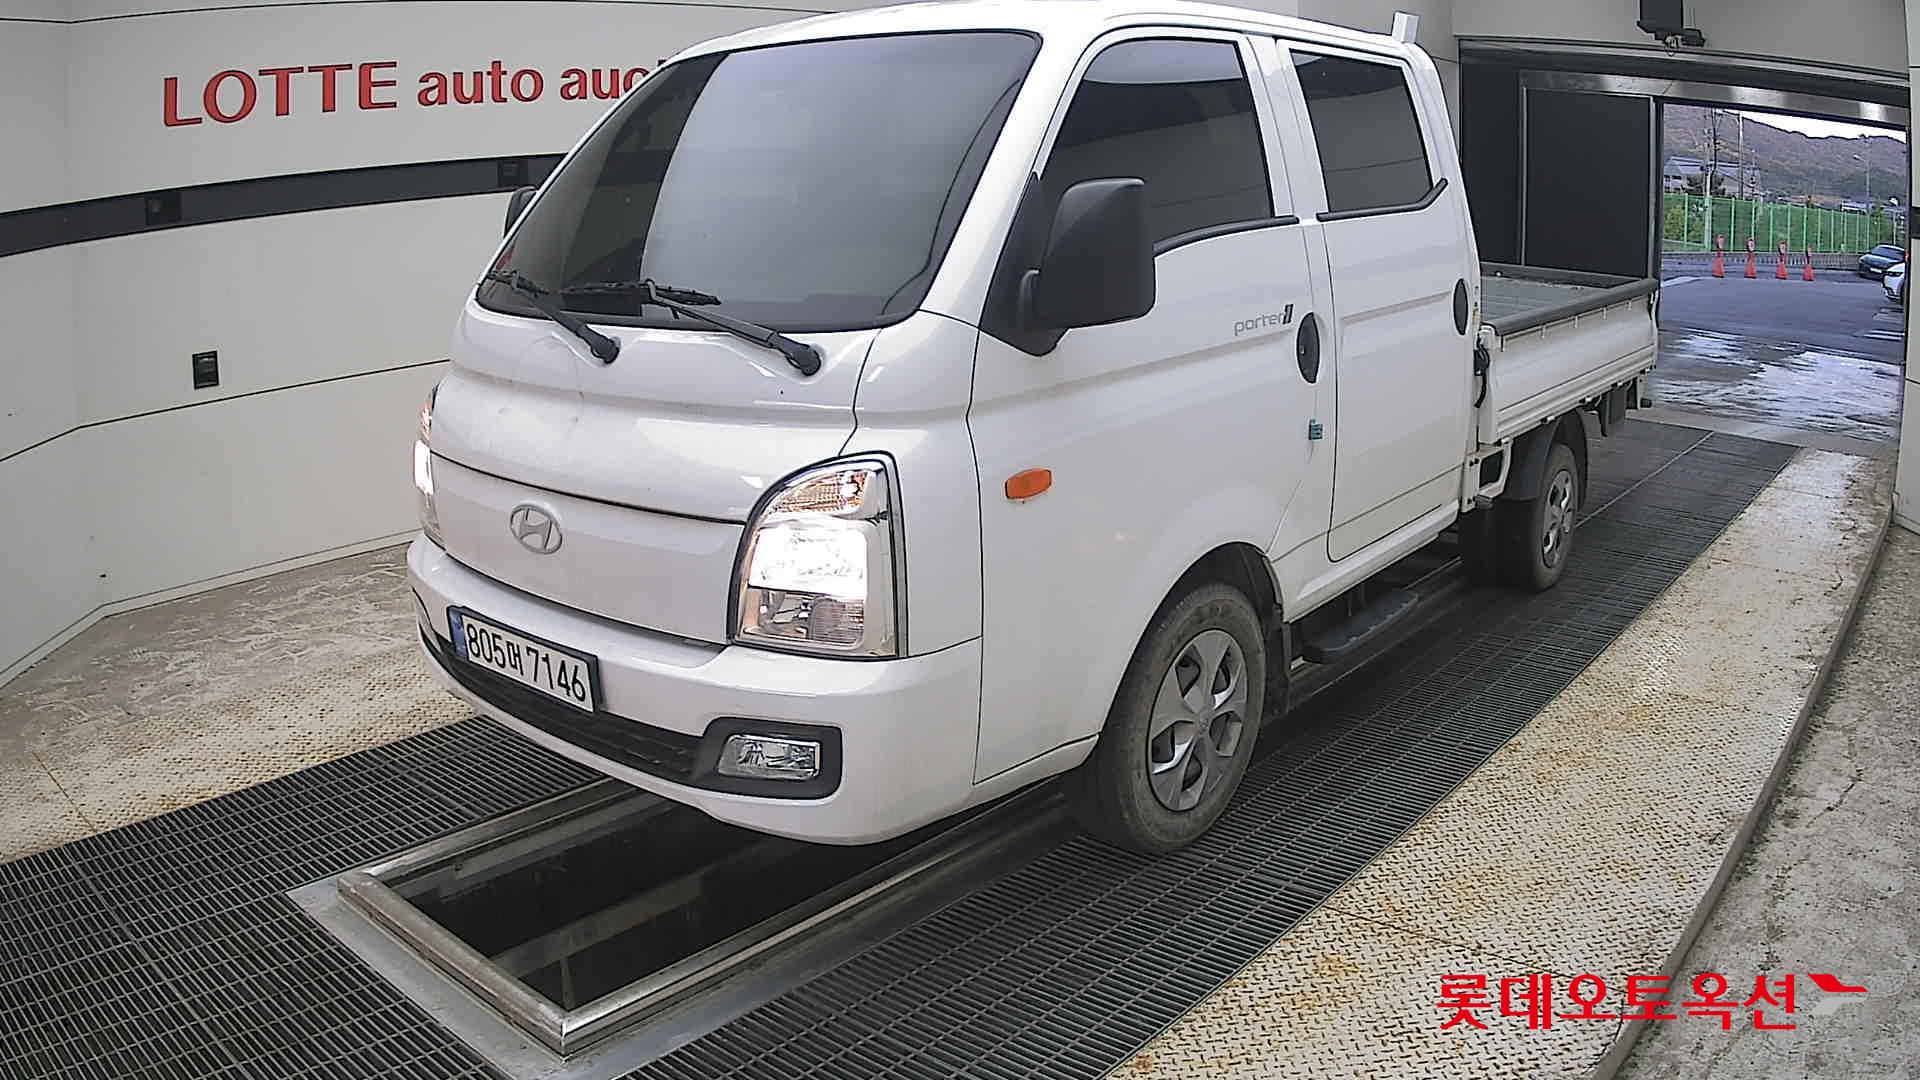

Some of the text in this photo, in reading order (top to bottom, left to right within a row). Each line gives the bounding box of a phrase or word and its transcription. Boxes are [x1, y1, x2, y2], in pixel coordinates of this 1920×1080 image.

[163, 58, 668, 127] LOTTE auto auc
